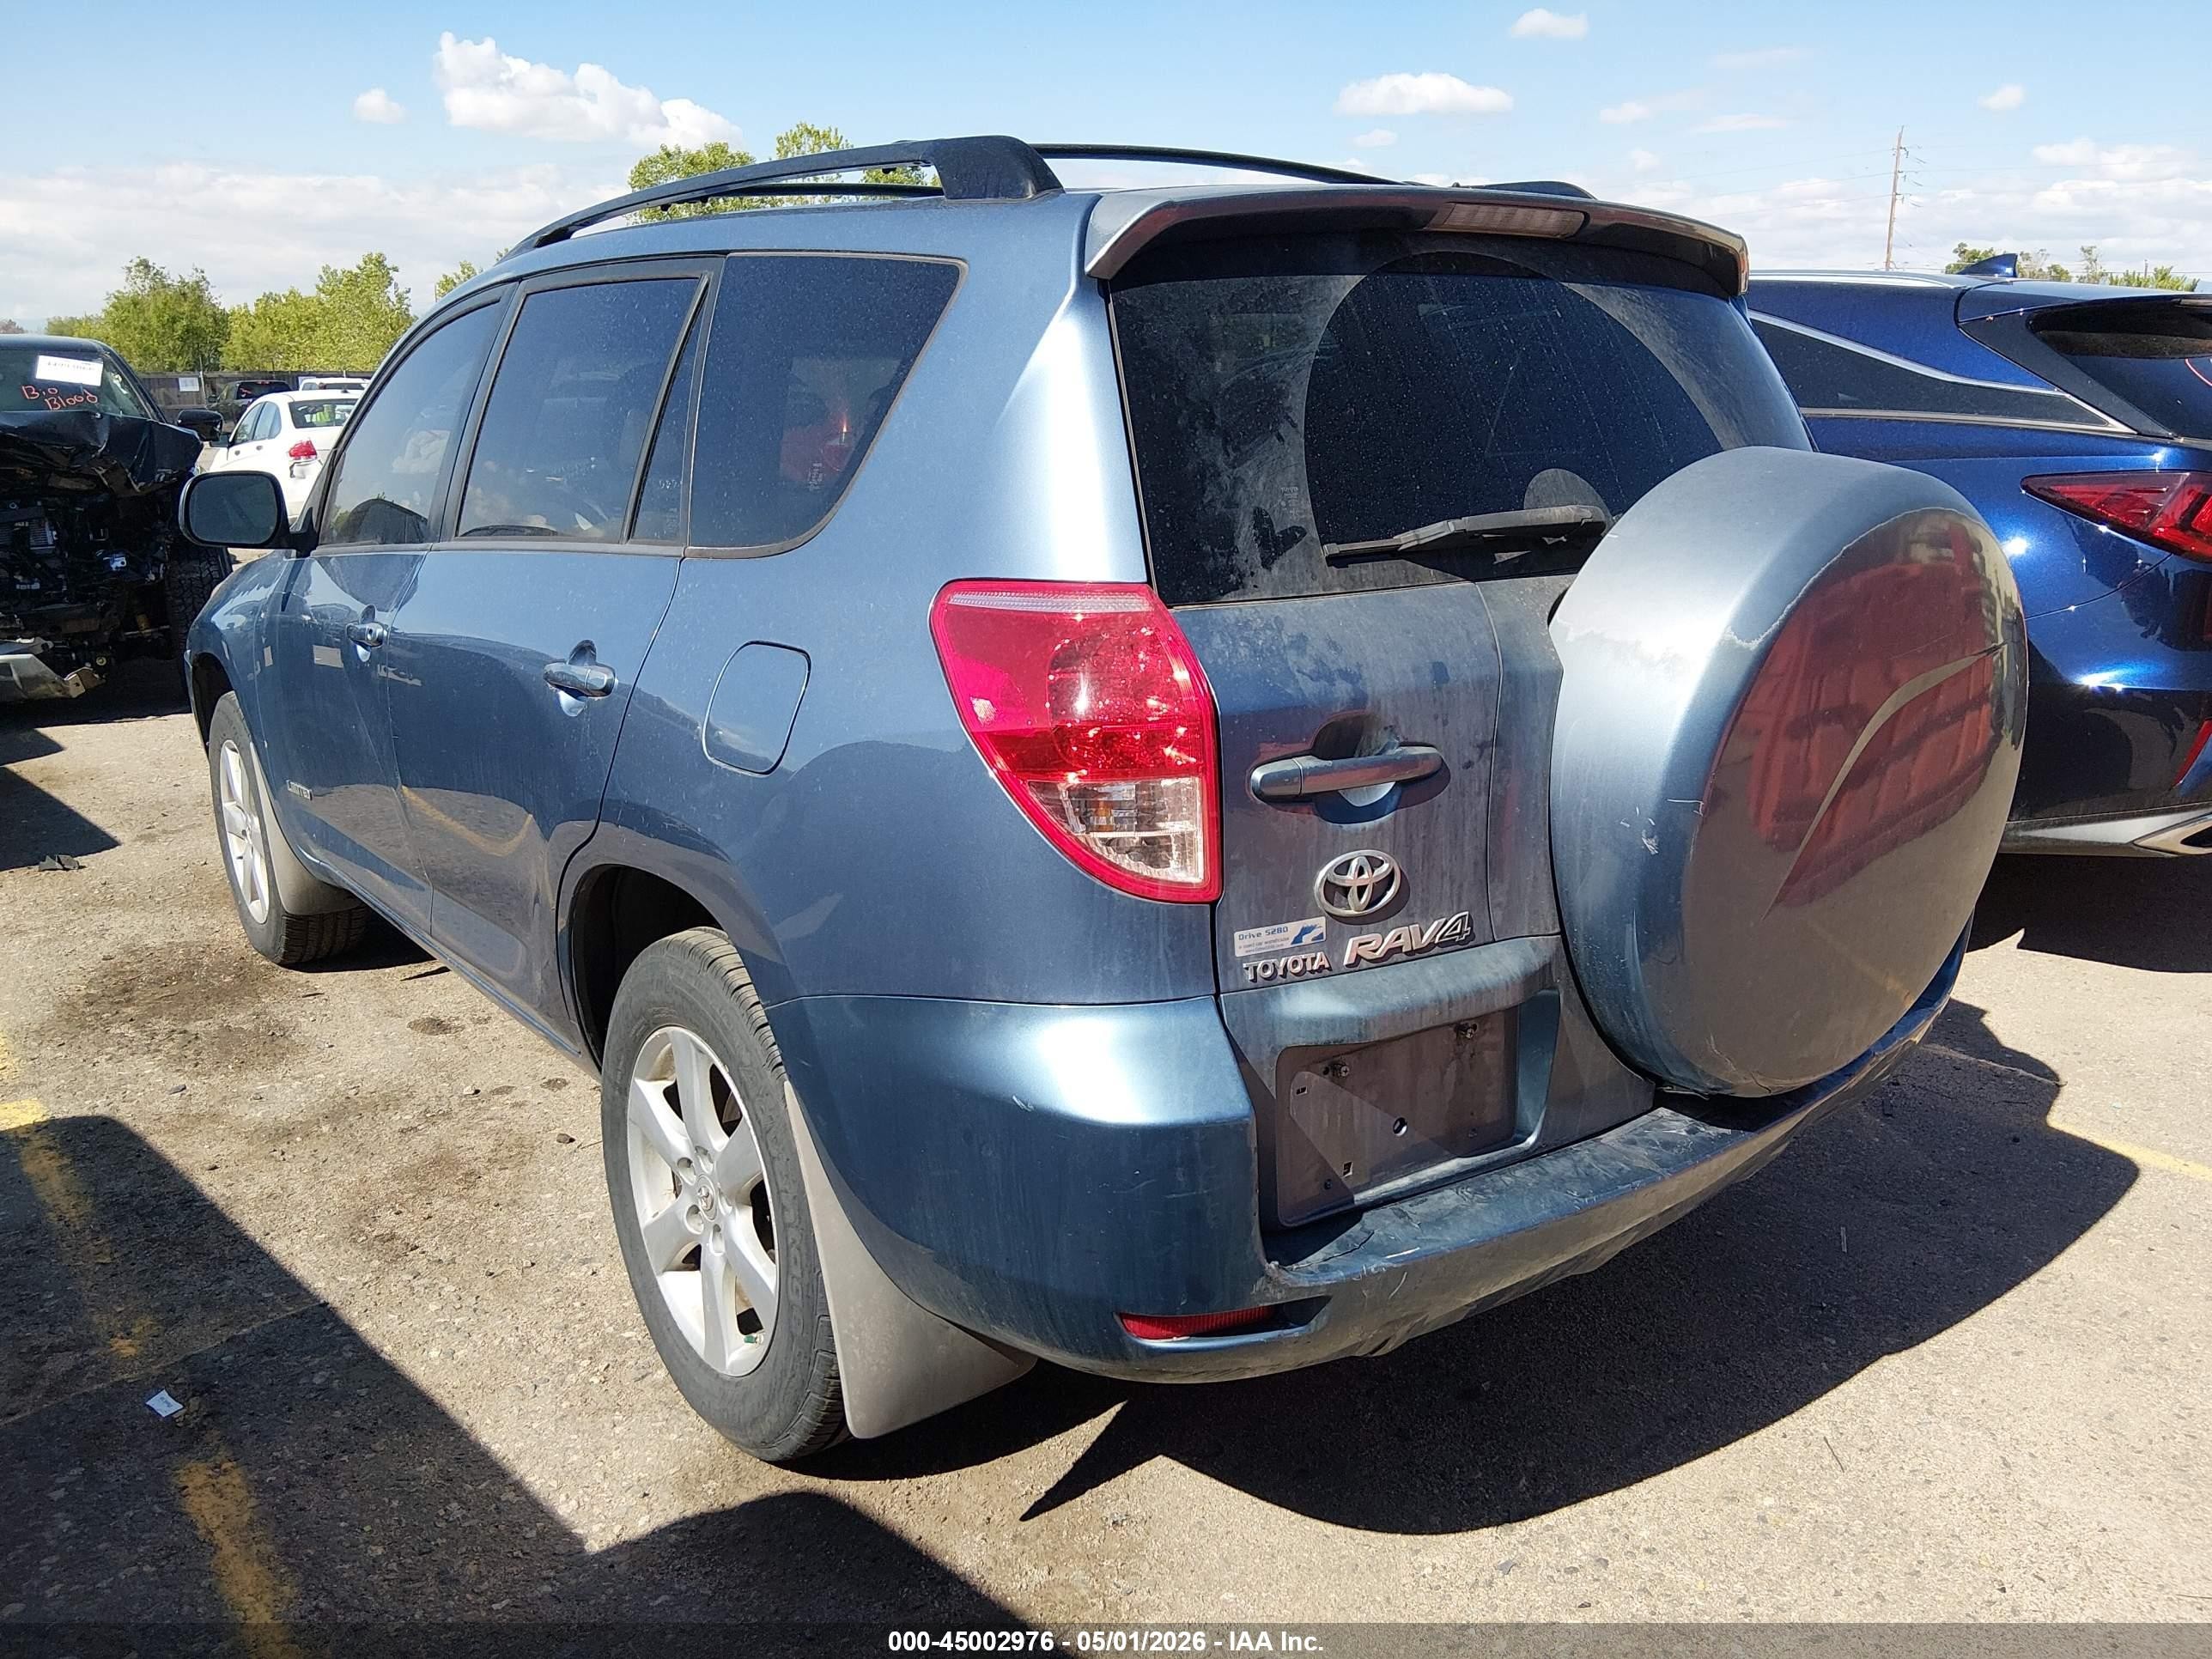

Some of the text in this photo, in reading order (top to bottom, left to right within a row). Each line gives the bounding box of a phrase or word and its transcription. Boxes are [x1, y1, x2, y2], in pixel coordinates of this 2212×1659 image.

[44, 389, 98, 410] Blood
[1238, 932, 1262, 941] Drive
[1243, 911, 1472, 981] TOYOTA RAV4
